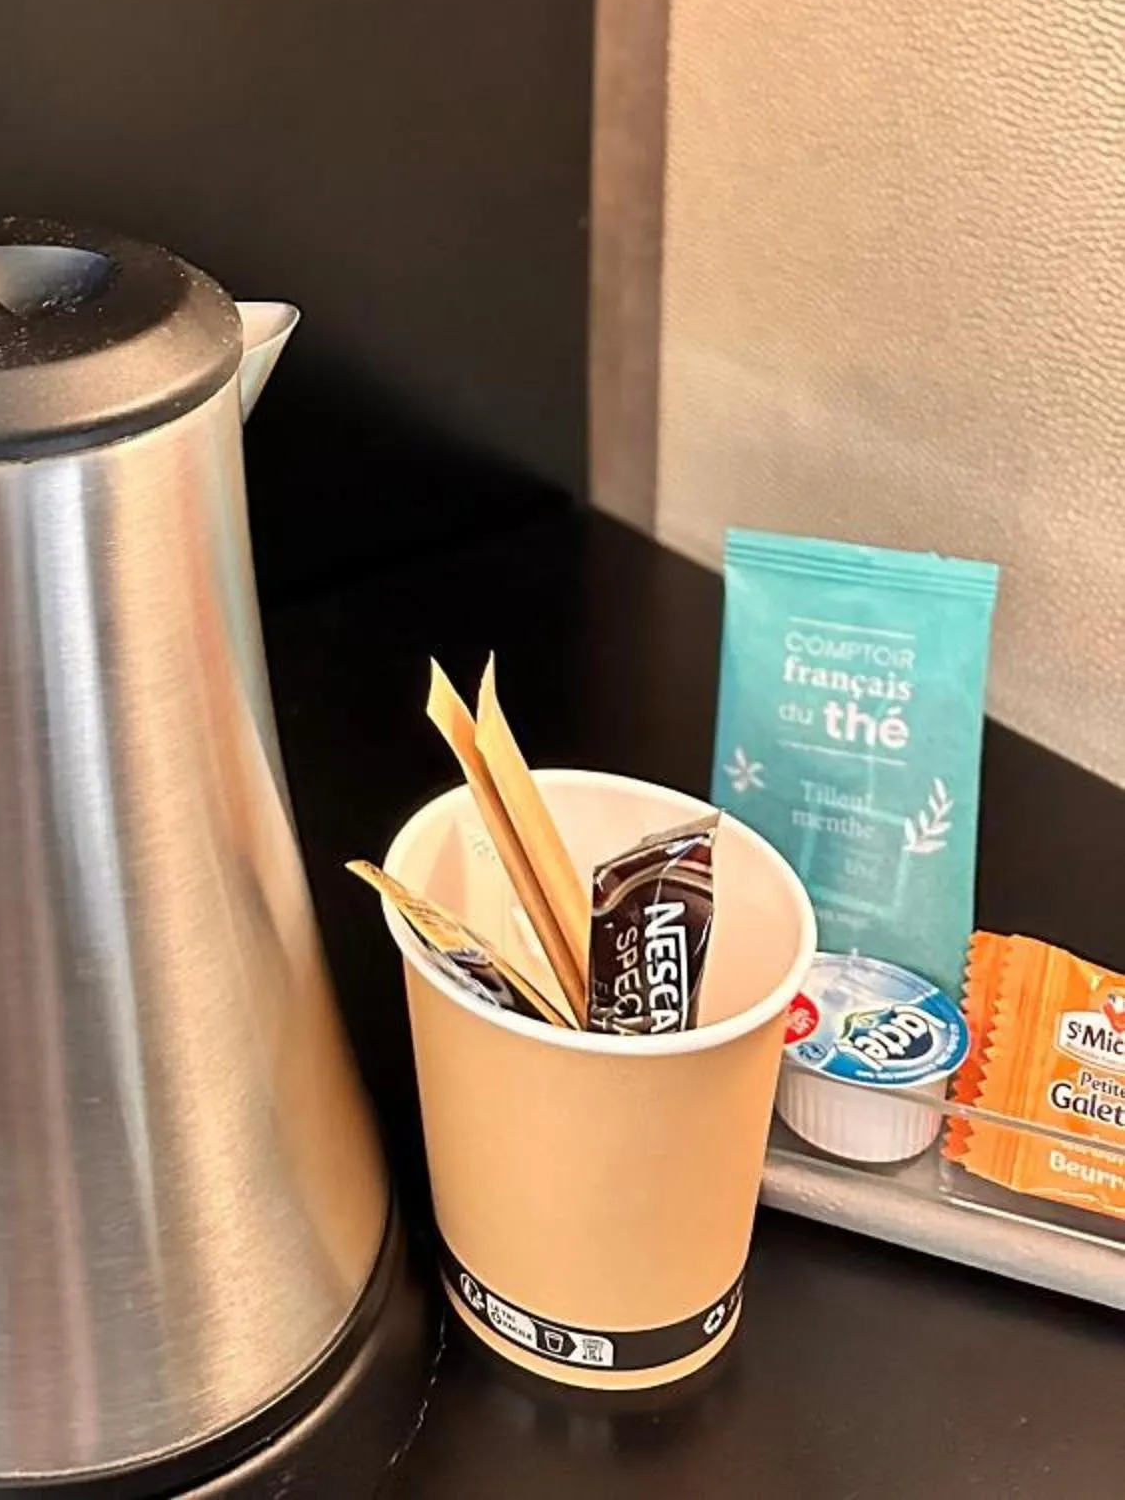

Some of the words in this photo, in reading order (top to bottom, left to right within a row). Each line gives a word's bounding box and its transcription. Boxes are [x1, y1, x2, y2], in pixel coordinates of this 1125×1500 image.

[784, 631, 916, 671] COMPTOIR
[782, 655, 913, 701] français
[778, 703, 814, 725] du
[822, 699, 910, 749] thé
